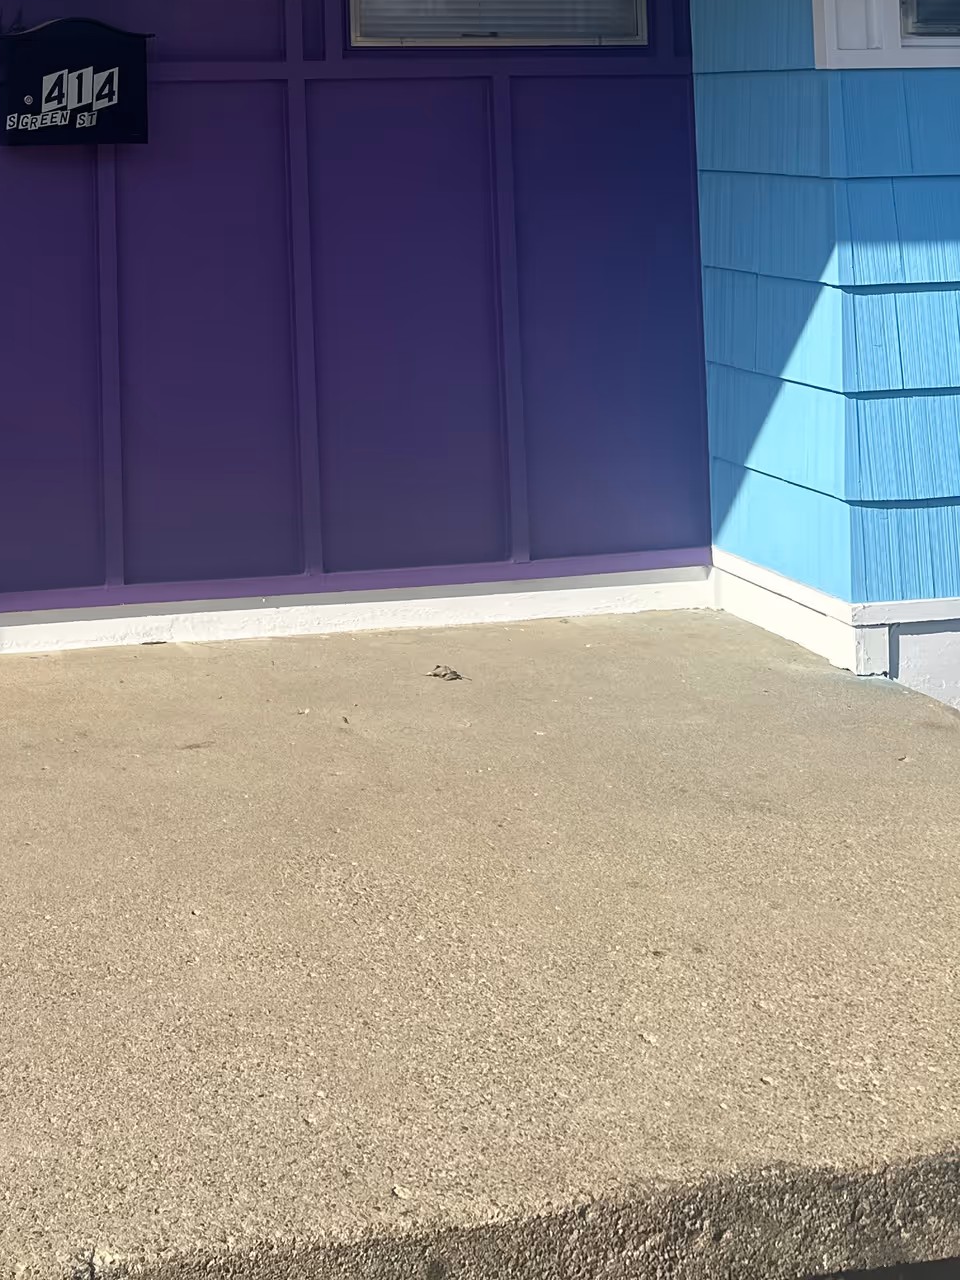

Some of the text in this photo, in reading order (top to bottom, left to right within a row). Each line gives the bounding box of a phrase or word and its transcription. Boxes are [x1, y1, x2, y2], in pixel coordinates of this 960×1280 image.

[44, 70, 116, 106] 414
[8, 111, 96, 129] S GREEN ST
